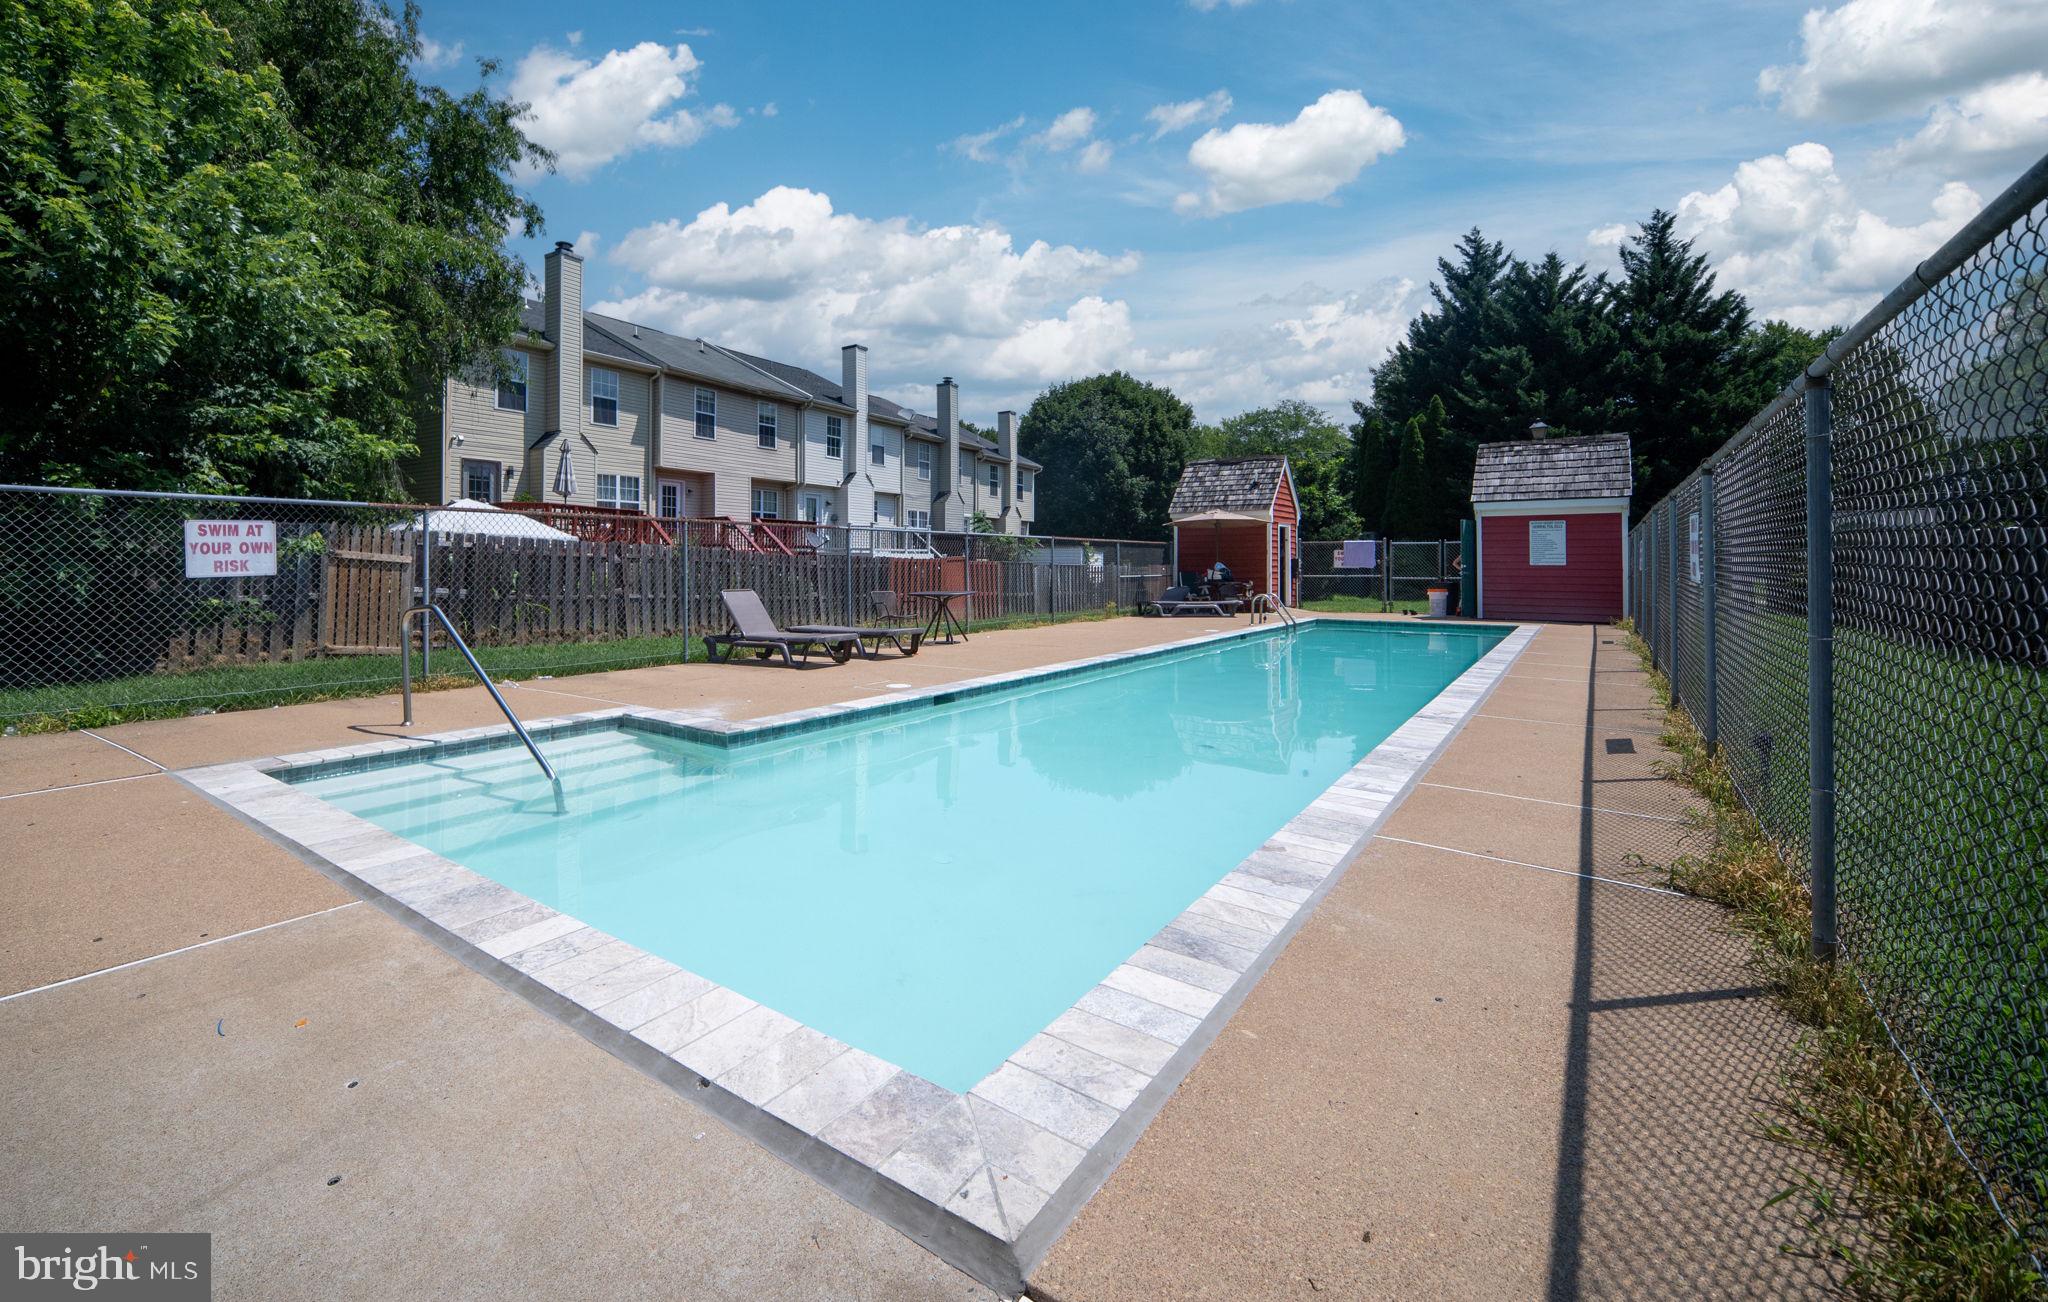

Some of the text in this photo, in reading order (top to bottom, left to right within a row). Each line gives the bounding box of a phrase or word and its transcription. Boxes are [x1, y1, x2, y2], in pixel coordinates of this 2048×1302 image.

[197, 523, 263, 537] SWIM AT
[189, 542, 273, 555] YOUR OWN
[213, 560, 250, 573] RISK
